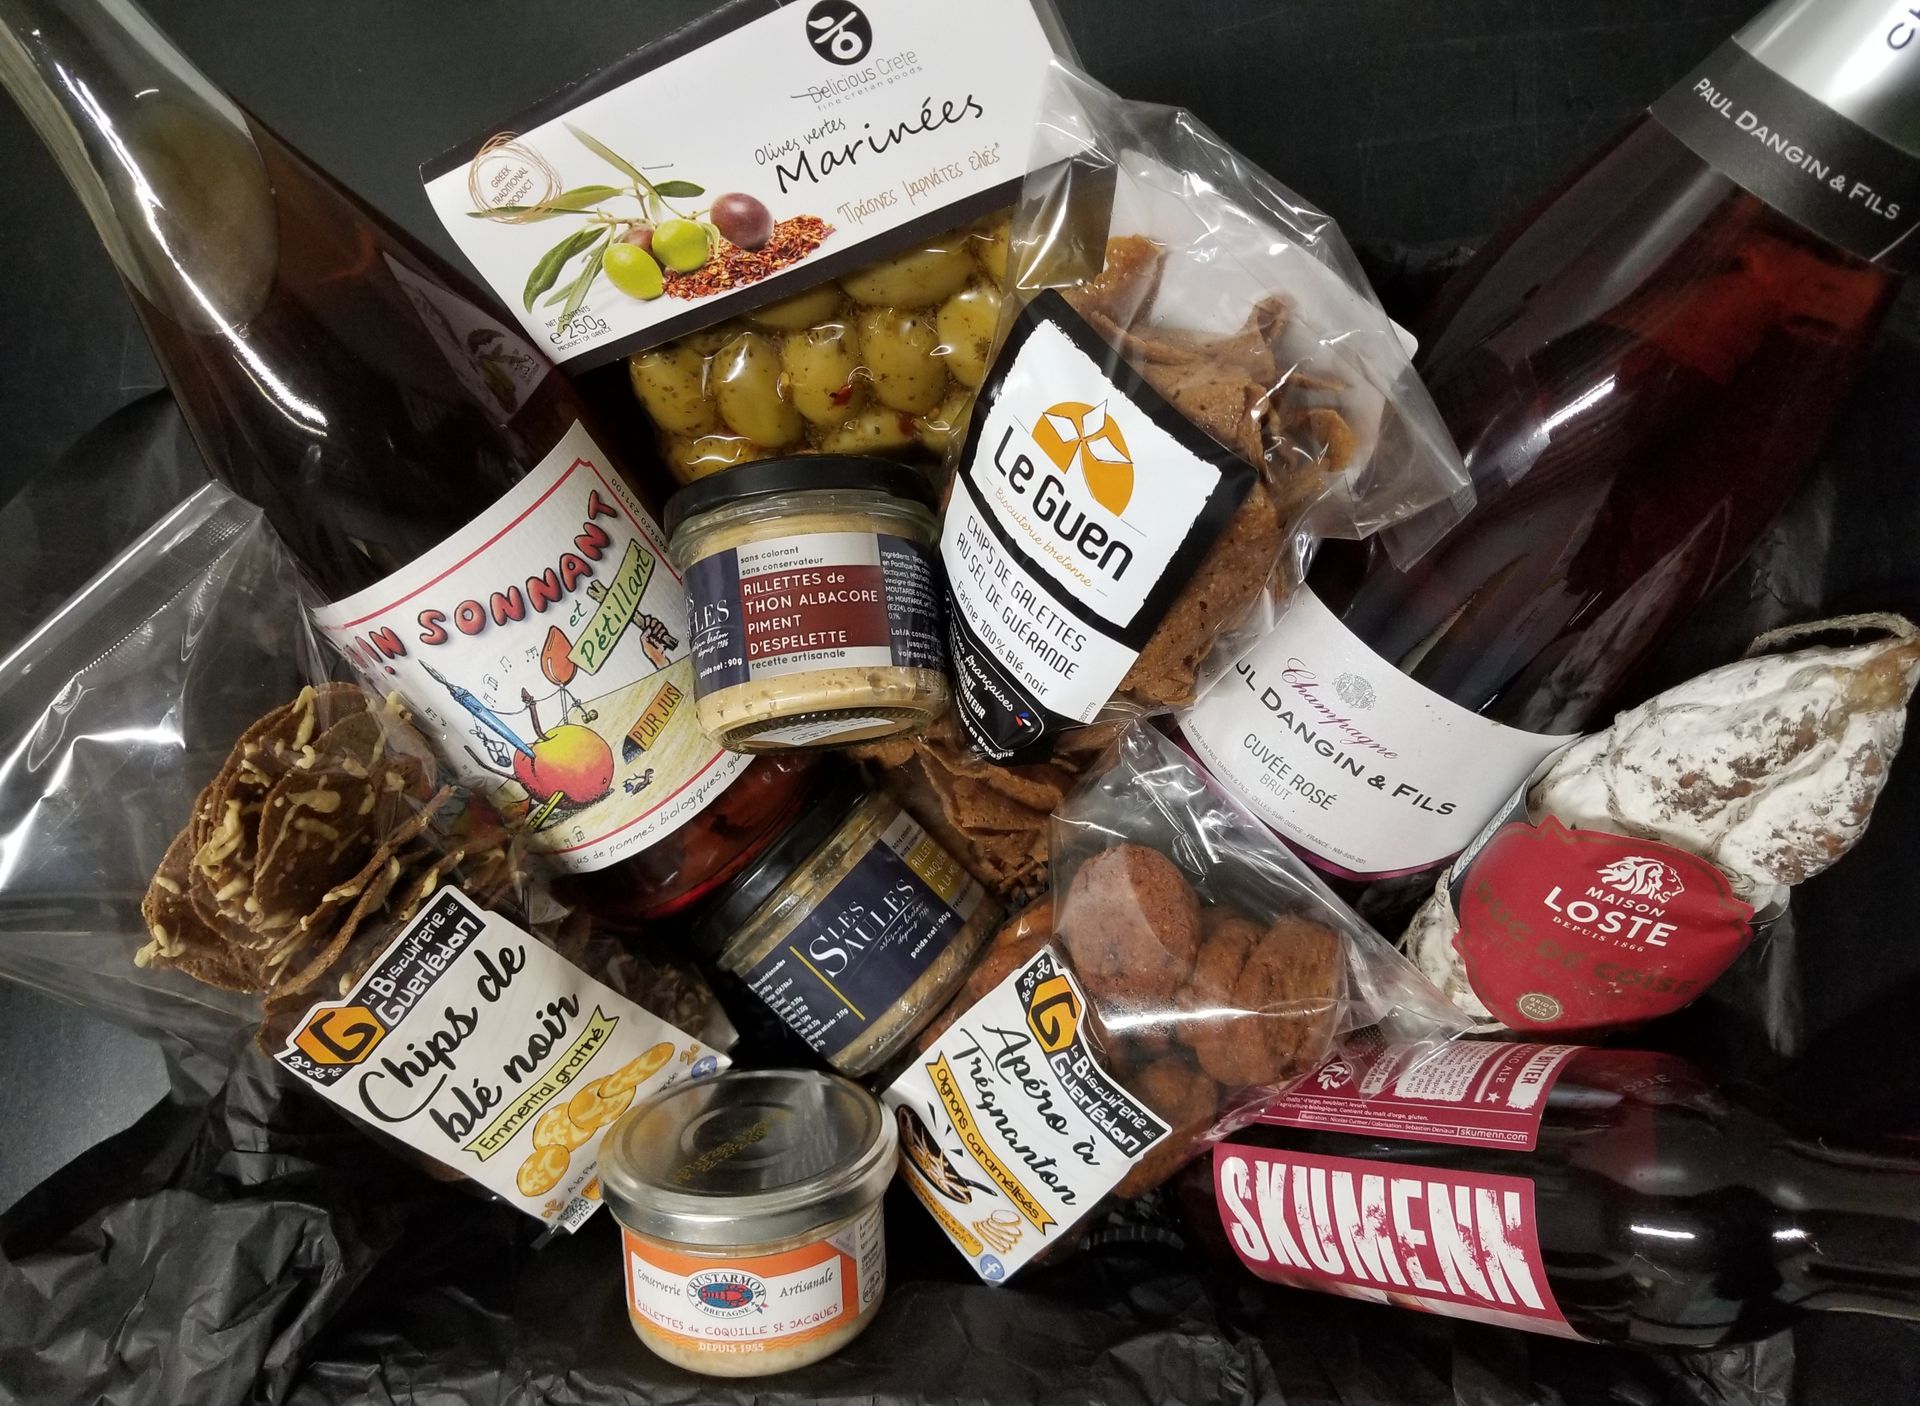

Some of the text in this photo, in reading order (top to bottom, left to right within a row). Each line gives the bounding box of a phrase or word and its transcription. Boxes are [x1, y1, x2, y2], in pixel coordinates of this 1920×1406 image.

[805, 50, 918, 104] Delicious Crete
[886, 65, 924, 86] goods
[754, 117, 847, 166] Olives vertes
[775, 94, 984, 195] Marinées
[1692, 77, 1901, 221] PAUL DANGIN & FILS
[490, 163, 512, 189] GREEK
[492, 166, 529, 206] TRADITIONAL
[505, 178, 535, 209] PRODUCT
[545, 318, 558, 329] NET
[562, 314, 609, 341] 250g
[993, 425, 1134, 582] Le Guen
[740, 546, 799, 565] sans colorant
[995, 486, 1093, 589] Biscuiterie bretonne
[417, 488, 618, 646] SONNANT
[741, 556, 824, 576] sans conservateur
[743, 572, 847, 596] RILLETTES de
[967, 515, 1088, 653] CHIPS DE GALETTES
[568, 597, 589, 628] et
[579, 547, 651, 670] Pétillant
[745, 590, 880, 616] THON ALBACORE
[747, 614, 803, 635] PIMENT
[956, 532, 1080, 681] AU SEL DE GUÉRANDE
[727, 658, 743, 668] 90g
[749, 631, 848, 656] D'ESPELETTE
[751, 649, 847, 670] recette artisanale
[956, 580, 980, 624] Farine
[978, 619, 1007, 656] 100%
[1004, 650, 1025, 675] Blé
[1023, 672, 1050, 698] noir
[964, 654, 1015, 713] françaises
[631, 682, 685, 747] PUR JUS
[1280, 656, 1400, 761] Champagne
[969, 725, 1015, 761] en Bretagne
[1259, 686, 1459, 816] DANGIN & FILS
[1243, 733, 1338, 812] CUVÉE ROSÉ
[1259, 773, 1293, 802] BRUT
[592, 850, 607, 861] de
[608, 825, 656, 859] pommes
[659, 768, 729, 827] biologiques,
[825, 900, 866, 940] LES
[1543, 885, 1678, 948] LOSTE
[1584, 885, 1666, 919] MAISON
[808, 878, 916, 979] SAULES
[910, 910, 953, 960] poids net 90g
[1552, 915, 1646, 954] DEPUIS 1866
[362, 900, 460, 1007] La Biscuiterie de
[375, 917, 479, 1027] Guerlédan
[358, 943, 527, 1124] Chips de
[429, 992, 582, 1144] blé noir
[483, 1024, 606, 1153] Emmental gratiné
[1070, 1053, 1148, 1131] Biscuiterie
[1495, 1064, 1514, 1084] ALE
[1520, 1053, 1552, 1084] BITTER
[982, 1024, 1101, 1166] Apéro à
[1050, 1052, 1142, 1154] Guerlédan
[1460, 1127, 1528, 1142] skumenn.com
[966, 1131, 1040, 1220] caramélisés
[1220, 1155, 1546, 1311] SKUMENN
[637, 1268, 682, 1297] Conserverie
[779, 1267, 834, 1299] Artisanale
[687, 1271, 766, 1299] CRUSTARMOR
[688, 1323, 701, 1333] de
[704, 1324, 768, 1338] COQUILLE
[772, 1322, 785, 1334] St
[789, 1302, 839, 1330] JACQUES
[702, 1305, 752, 1319] BRETAGNE
[699, 1342, 738, 1354] DEPUIS
